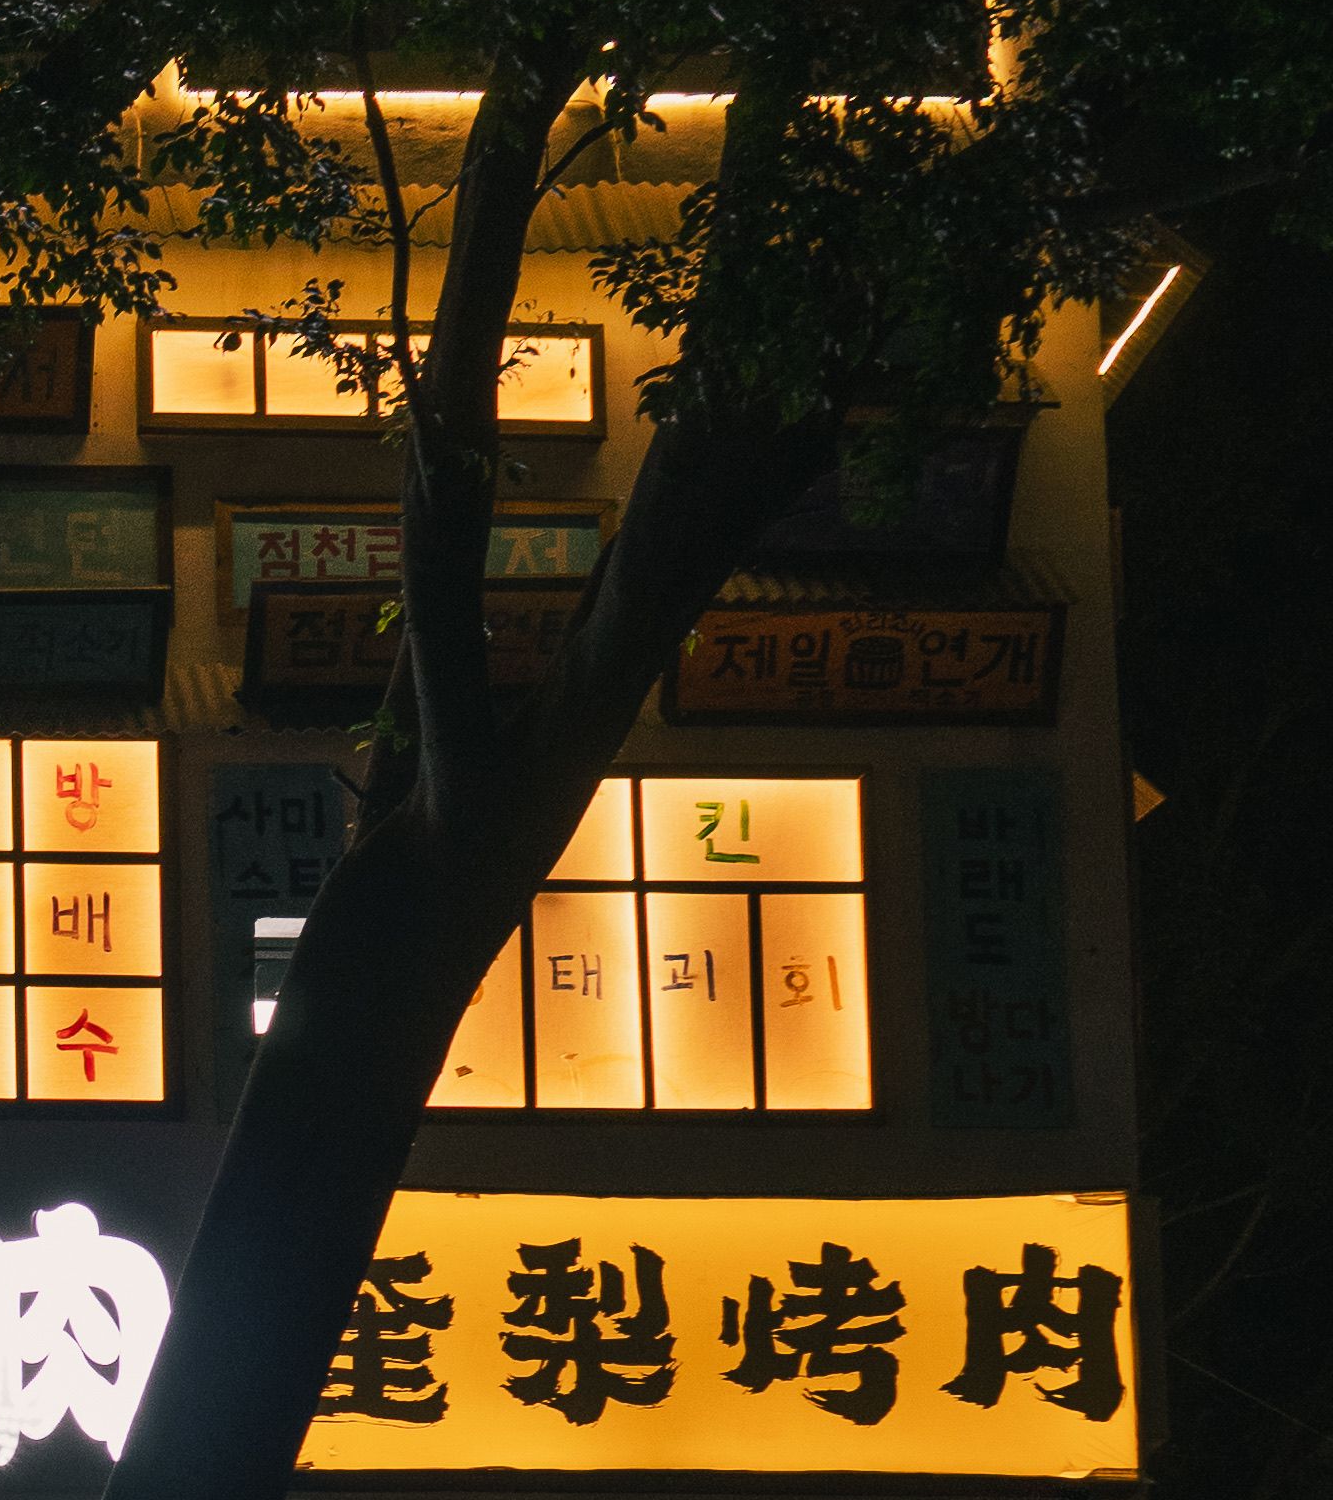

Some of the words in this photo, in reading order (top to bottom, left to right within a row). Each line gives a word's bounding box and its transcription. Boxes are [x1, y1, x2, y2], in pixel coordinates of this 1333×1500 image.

[55, 761, 114, 832] 방
[694, 800, 762, 864] 킨
[50, 890, 113, 953] 배
[780, 954, 843, 1010] 회
[55, 1007, 120, 1083] 수
[318, 1237, 1125, 1427] 奎梨烤肉
